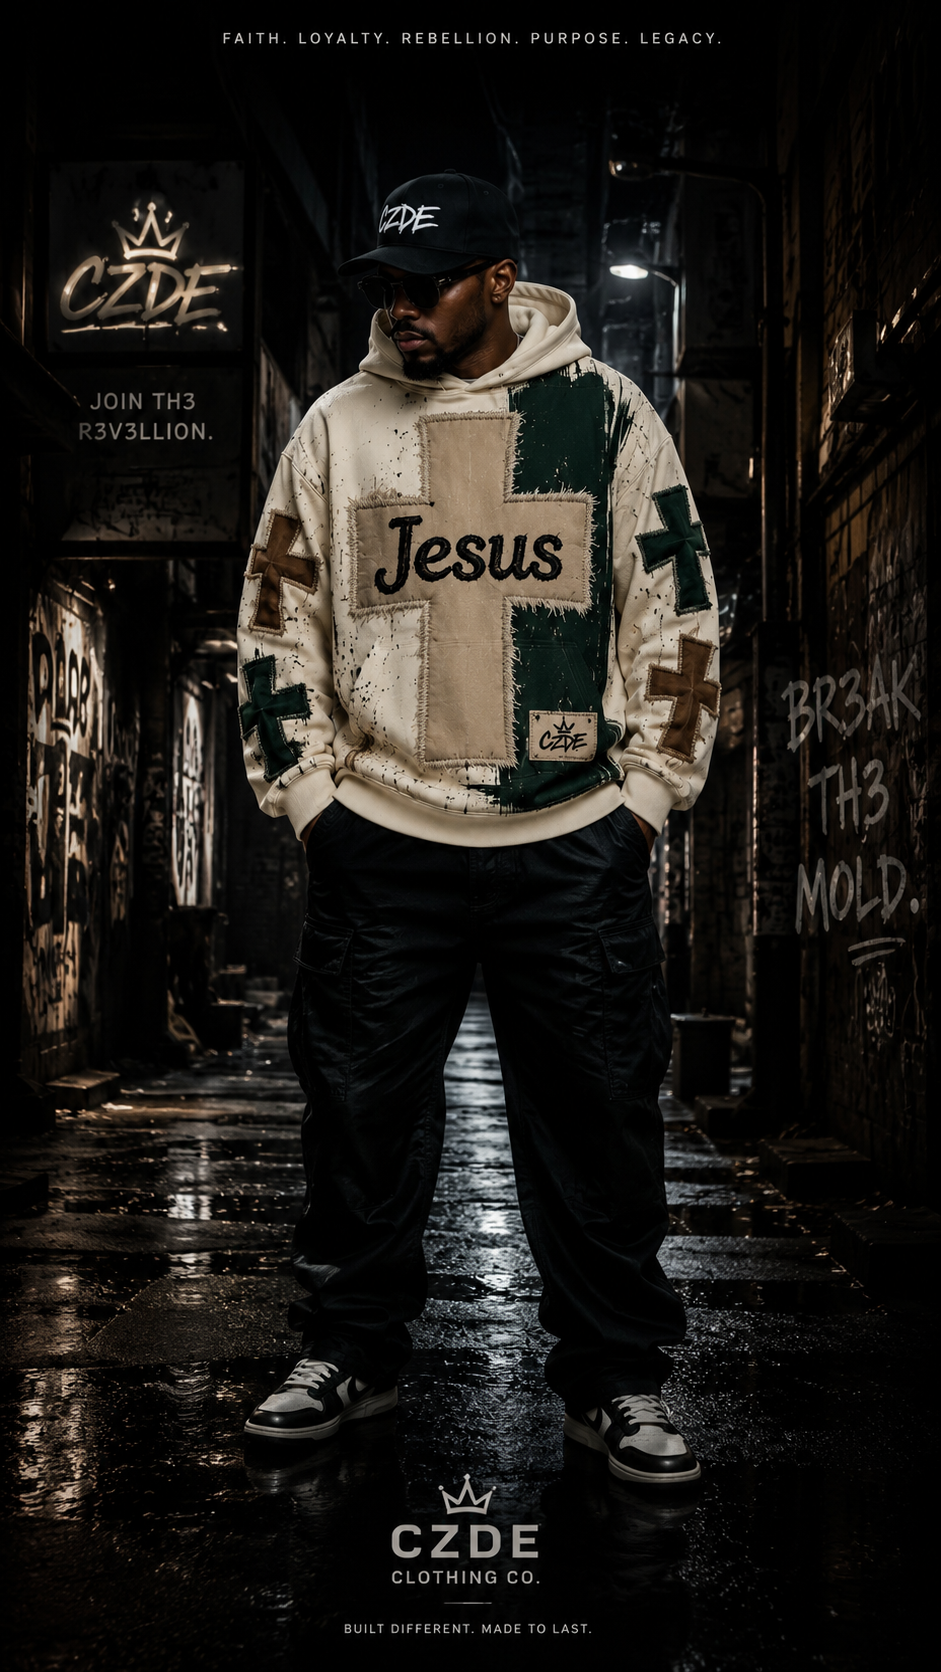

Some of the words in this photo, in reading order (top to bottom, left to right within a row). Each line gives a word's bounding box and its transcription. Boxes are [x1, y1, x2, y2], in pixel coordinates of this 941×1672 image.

[378, 203, 441, 234] CZDE
[60, 255, 233, 325] CZDE
[78, 422, 213, 440] R3V3LLION.
[90, 392, 142, 410] JOIN
[152, 392, 196, 410] TH3
[374, 516, 563, 596] Jesus
[781, 652, 922, 753] BR3AK
[539, 730, 588, 753] CZDE
[807, 756, 890, 836] TH3
[795, 854, 920, 934] MOLD.
